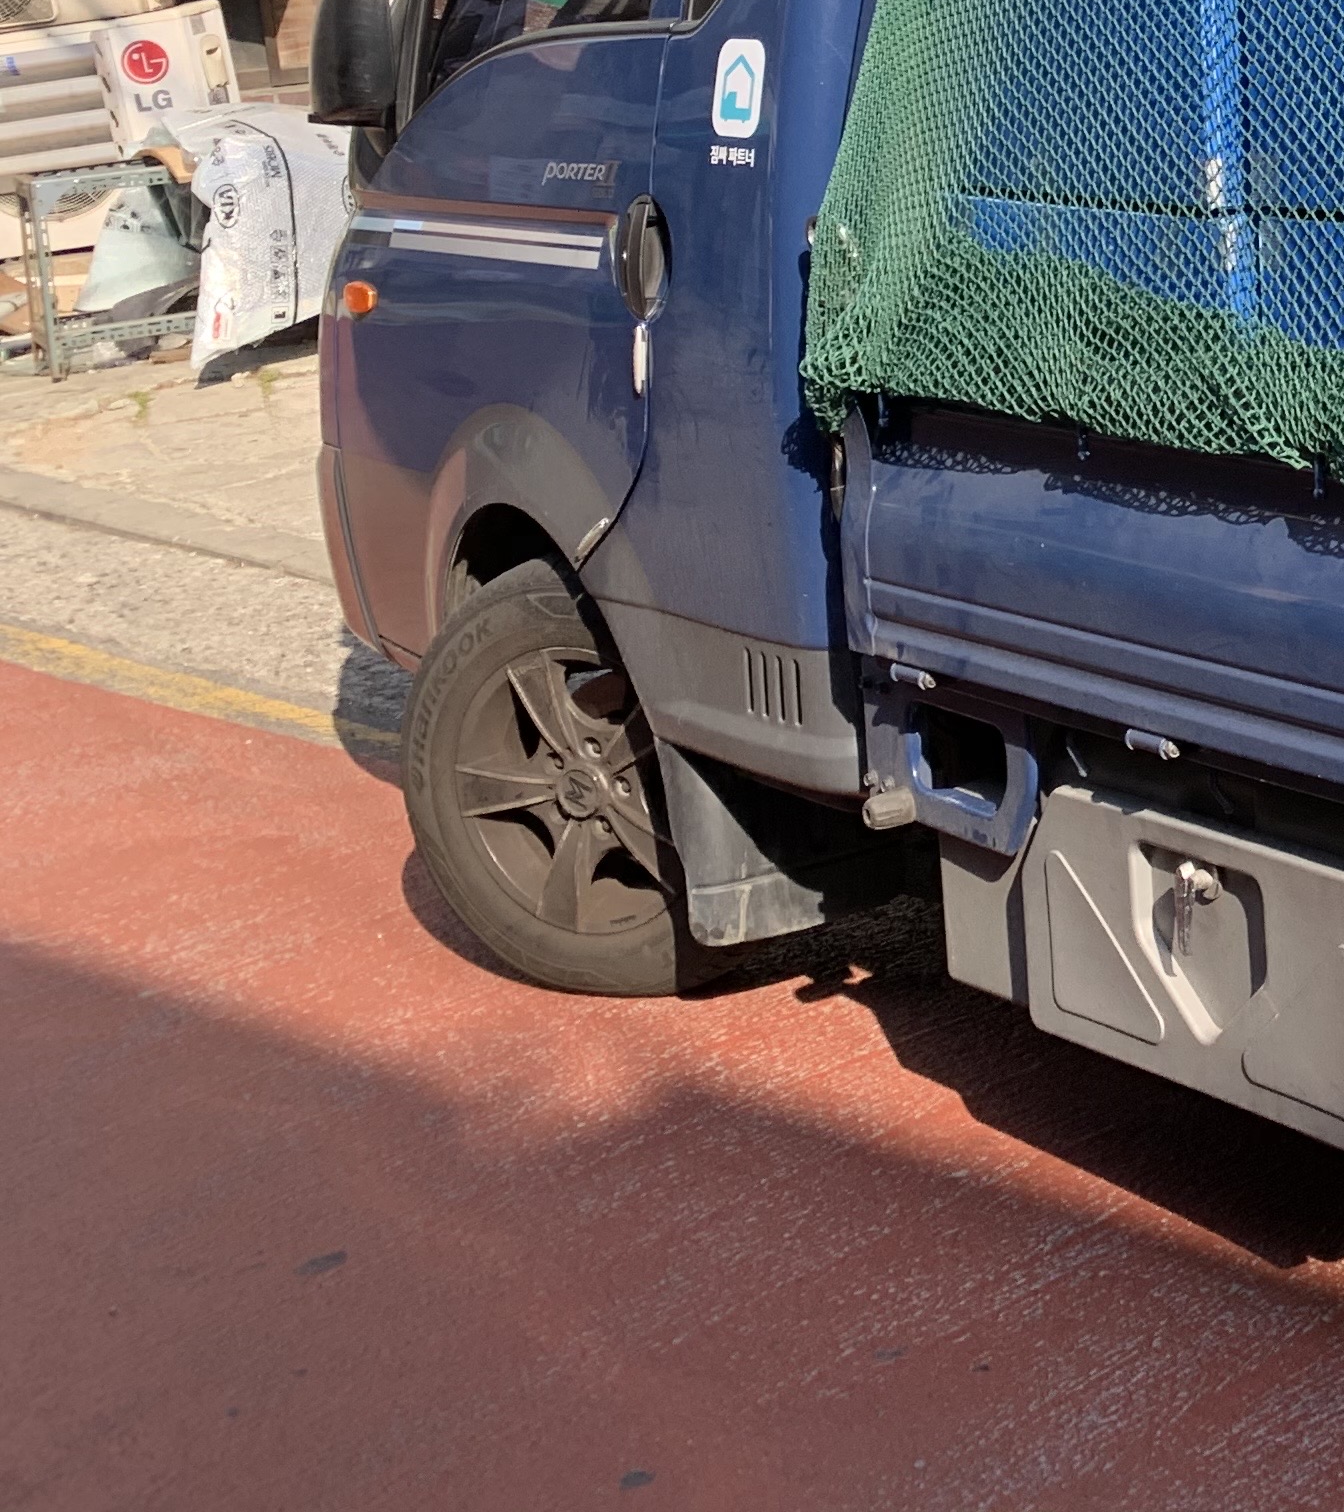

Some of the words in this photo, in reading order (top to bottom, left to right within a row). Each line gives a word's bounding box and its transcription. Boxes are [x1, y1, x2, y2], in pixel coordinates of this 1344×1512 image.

[134, 89, 173, 113] LG
[728, 147, 756, 168] 파트너
[541, 161, 606, 186] PORTER
[217, 188, 236, 221] KIA
